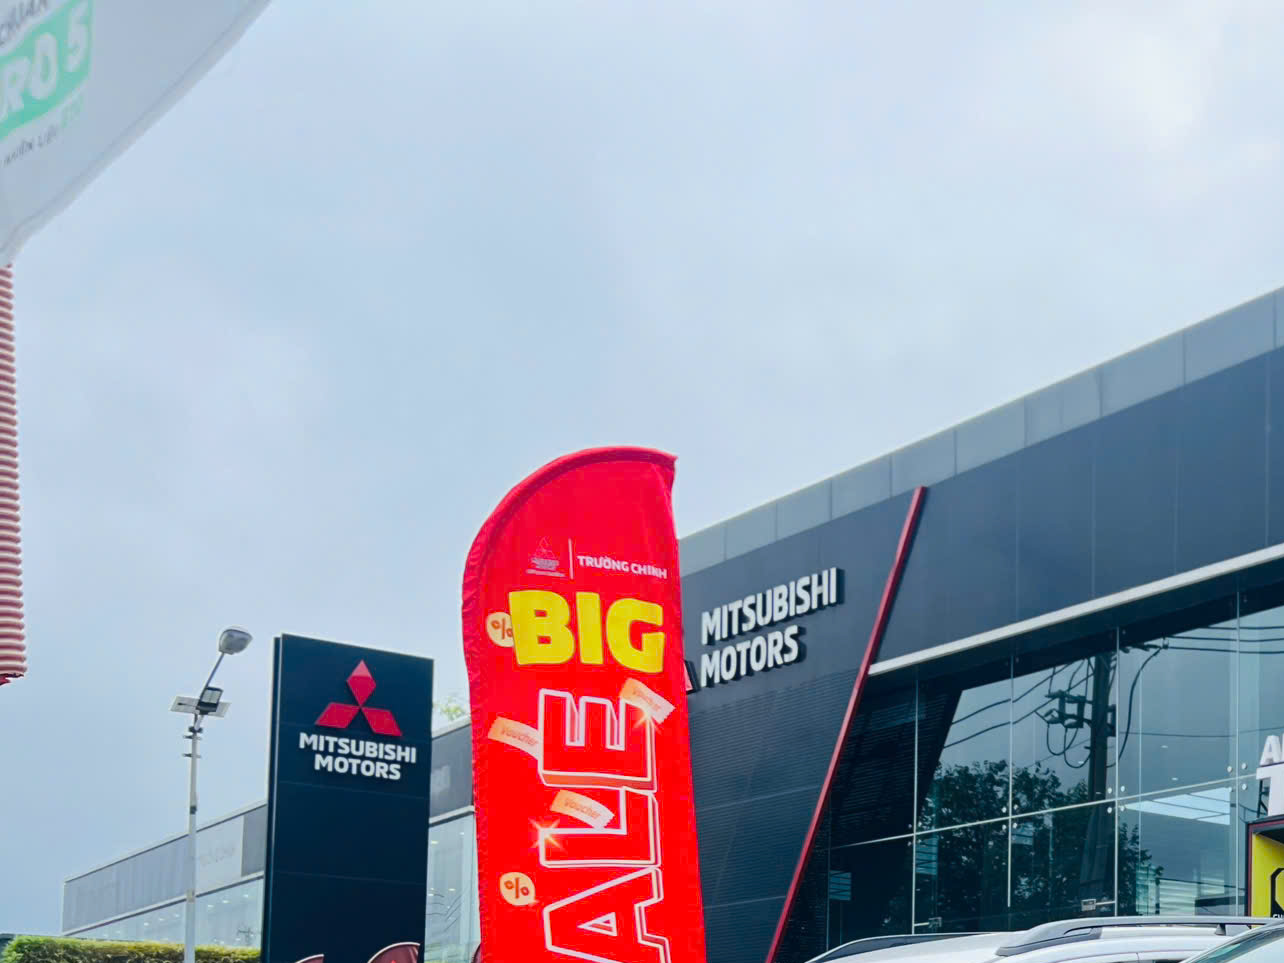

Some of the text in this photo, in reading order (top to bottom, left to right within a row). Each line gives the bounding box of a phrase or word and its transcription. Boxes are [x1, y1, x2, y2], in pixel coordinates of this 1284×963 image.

[630, 562, 667, 580] CHINH
[701, 566, 838, 646] MITSUBISHI
[508, 589, 665, 673] BIG
[700, 624, 799, 688] MOTORS
[298, 731, 417, 764] MITSUBISHI
[313, 753, 401, 781] MOTORS
